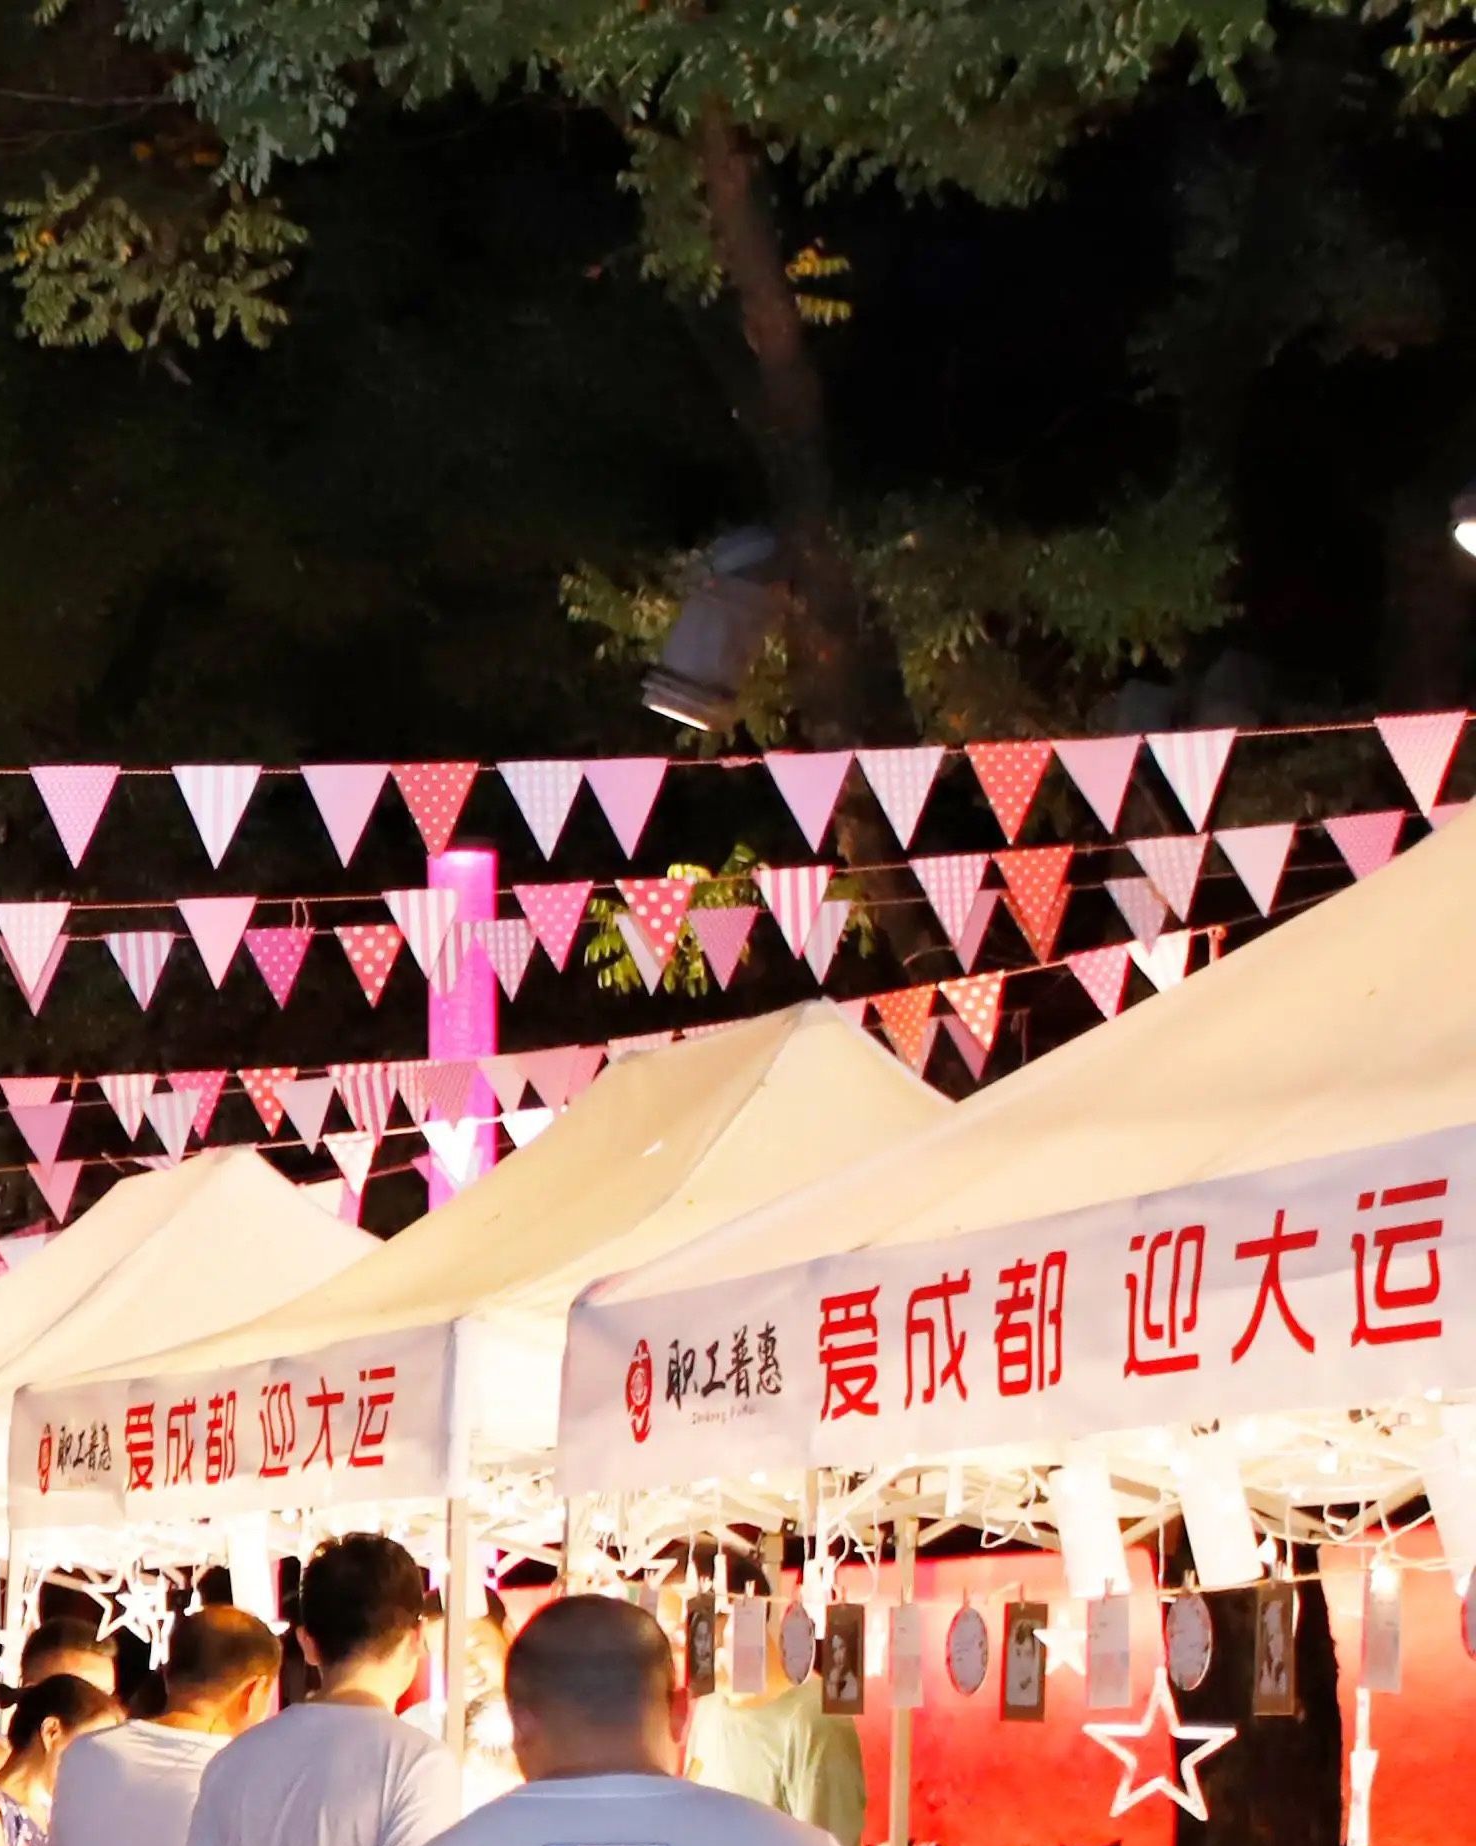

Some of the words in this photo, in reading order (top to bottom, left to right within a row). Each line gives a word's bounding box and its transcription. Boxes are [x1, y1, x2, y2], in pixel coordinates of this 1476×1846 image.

[818, 1250, 1069, 1423] 爱成都
[1123, 1177, 1449, 1380] 迎大运
[665, 1319, 783, 1411] 职工普惠
[123, 1391, 238, 1494] 爱成都
[258, 1366, 396, 1478] 迎大运
